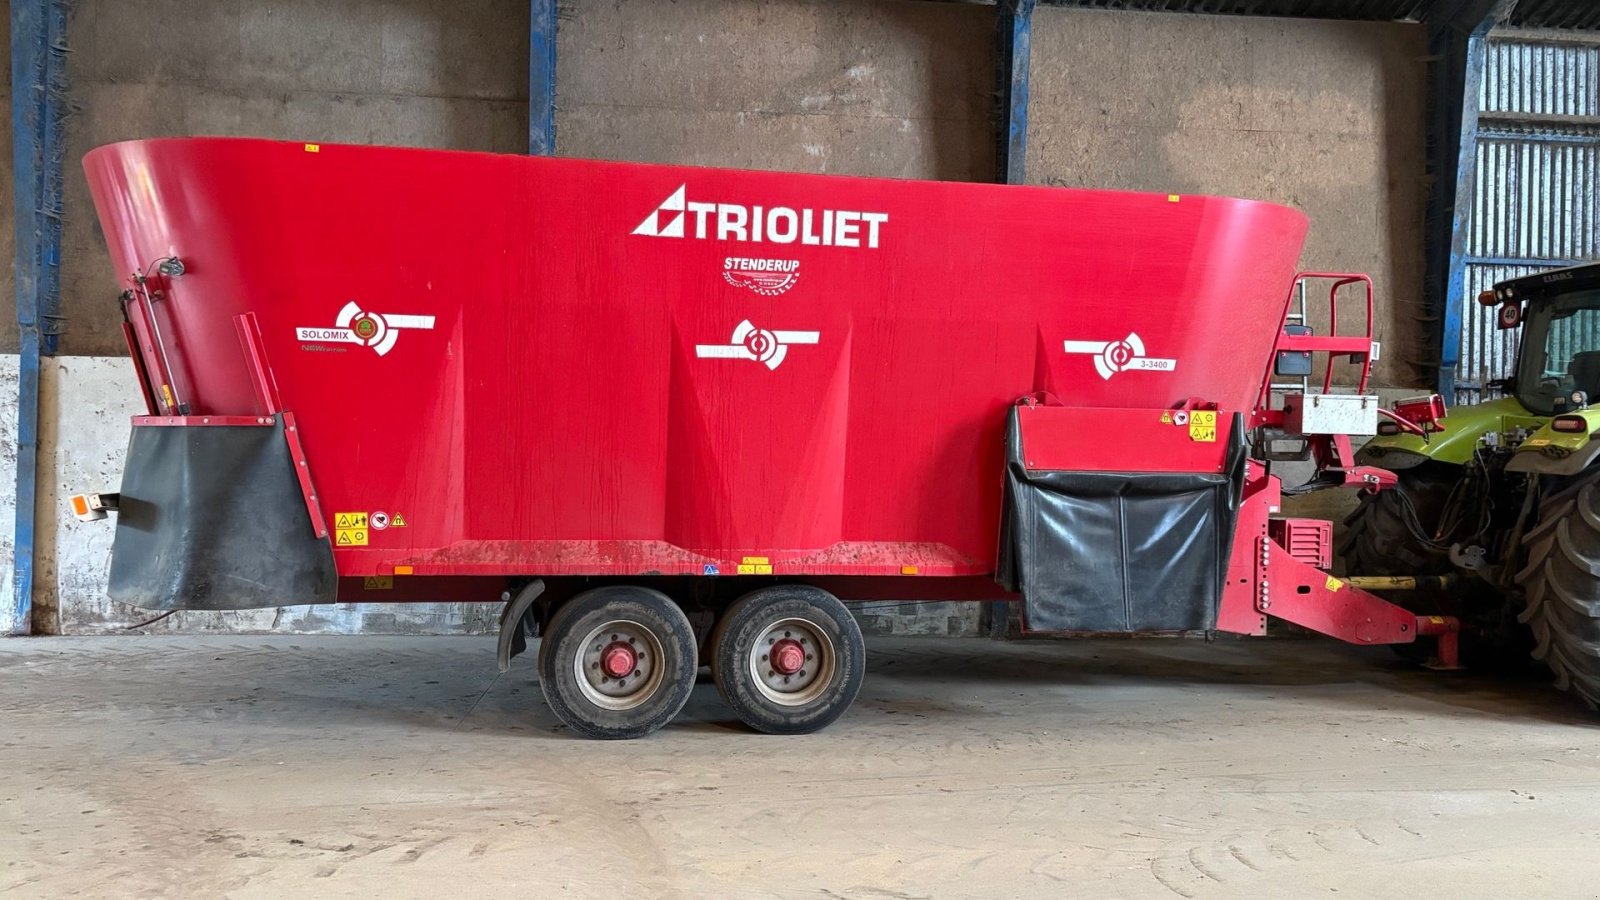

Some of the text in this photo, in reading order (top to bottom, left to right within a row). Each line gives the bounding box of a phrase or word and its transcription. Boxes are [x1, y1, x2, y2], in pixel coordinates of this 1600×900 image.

[687, 201, 889, 249] TRIOLIET
[723, 257, 800, 272] STENDERUP
[1504, 308, 1515, 319] 40
[301, 330, 349, 340] SOLOMIX
[1140, 360, 1168, 369] 3-3400
